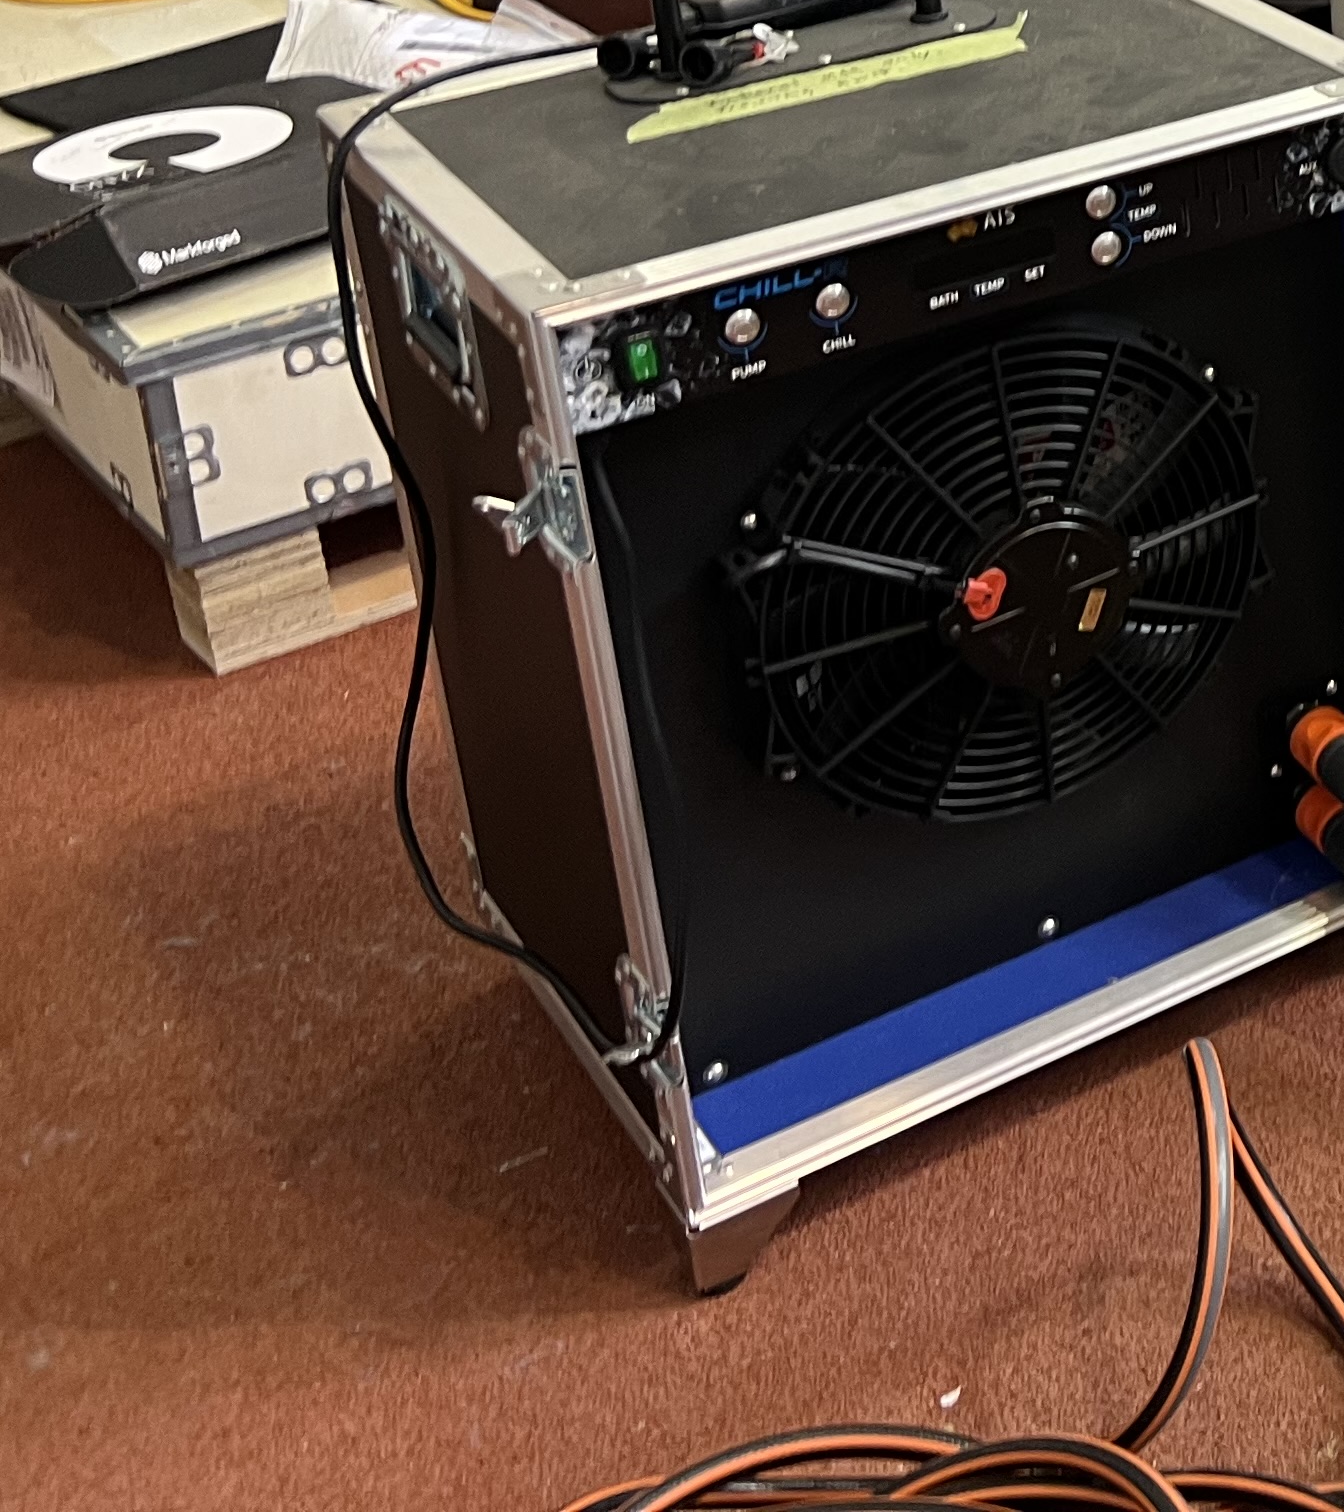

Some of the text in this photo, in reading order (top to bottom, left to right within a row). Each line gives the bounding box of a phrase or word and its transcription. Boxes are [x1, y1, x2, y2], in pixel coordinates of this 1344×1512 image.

[1138, 182, 1154, 196] UP
[1127, 203, 1157, 223] TEMP
[1143, 222, 1178, 244] DOWN
[929, 264, 1046, 311] BATH TEMP SET
[822, 333, 856, 355] CHILL
[731, 359, 767, 382] PUMP
